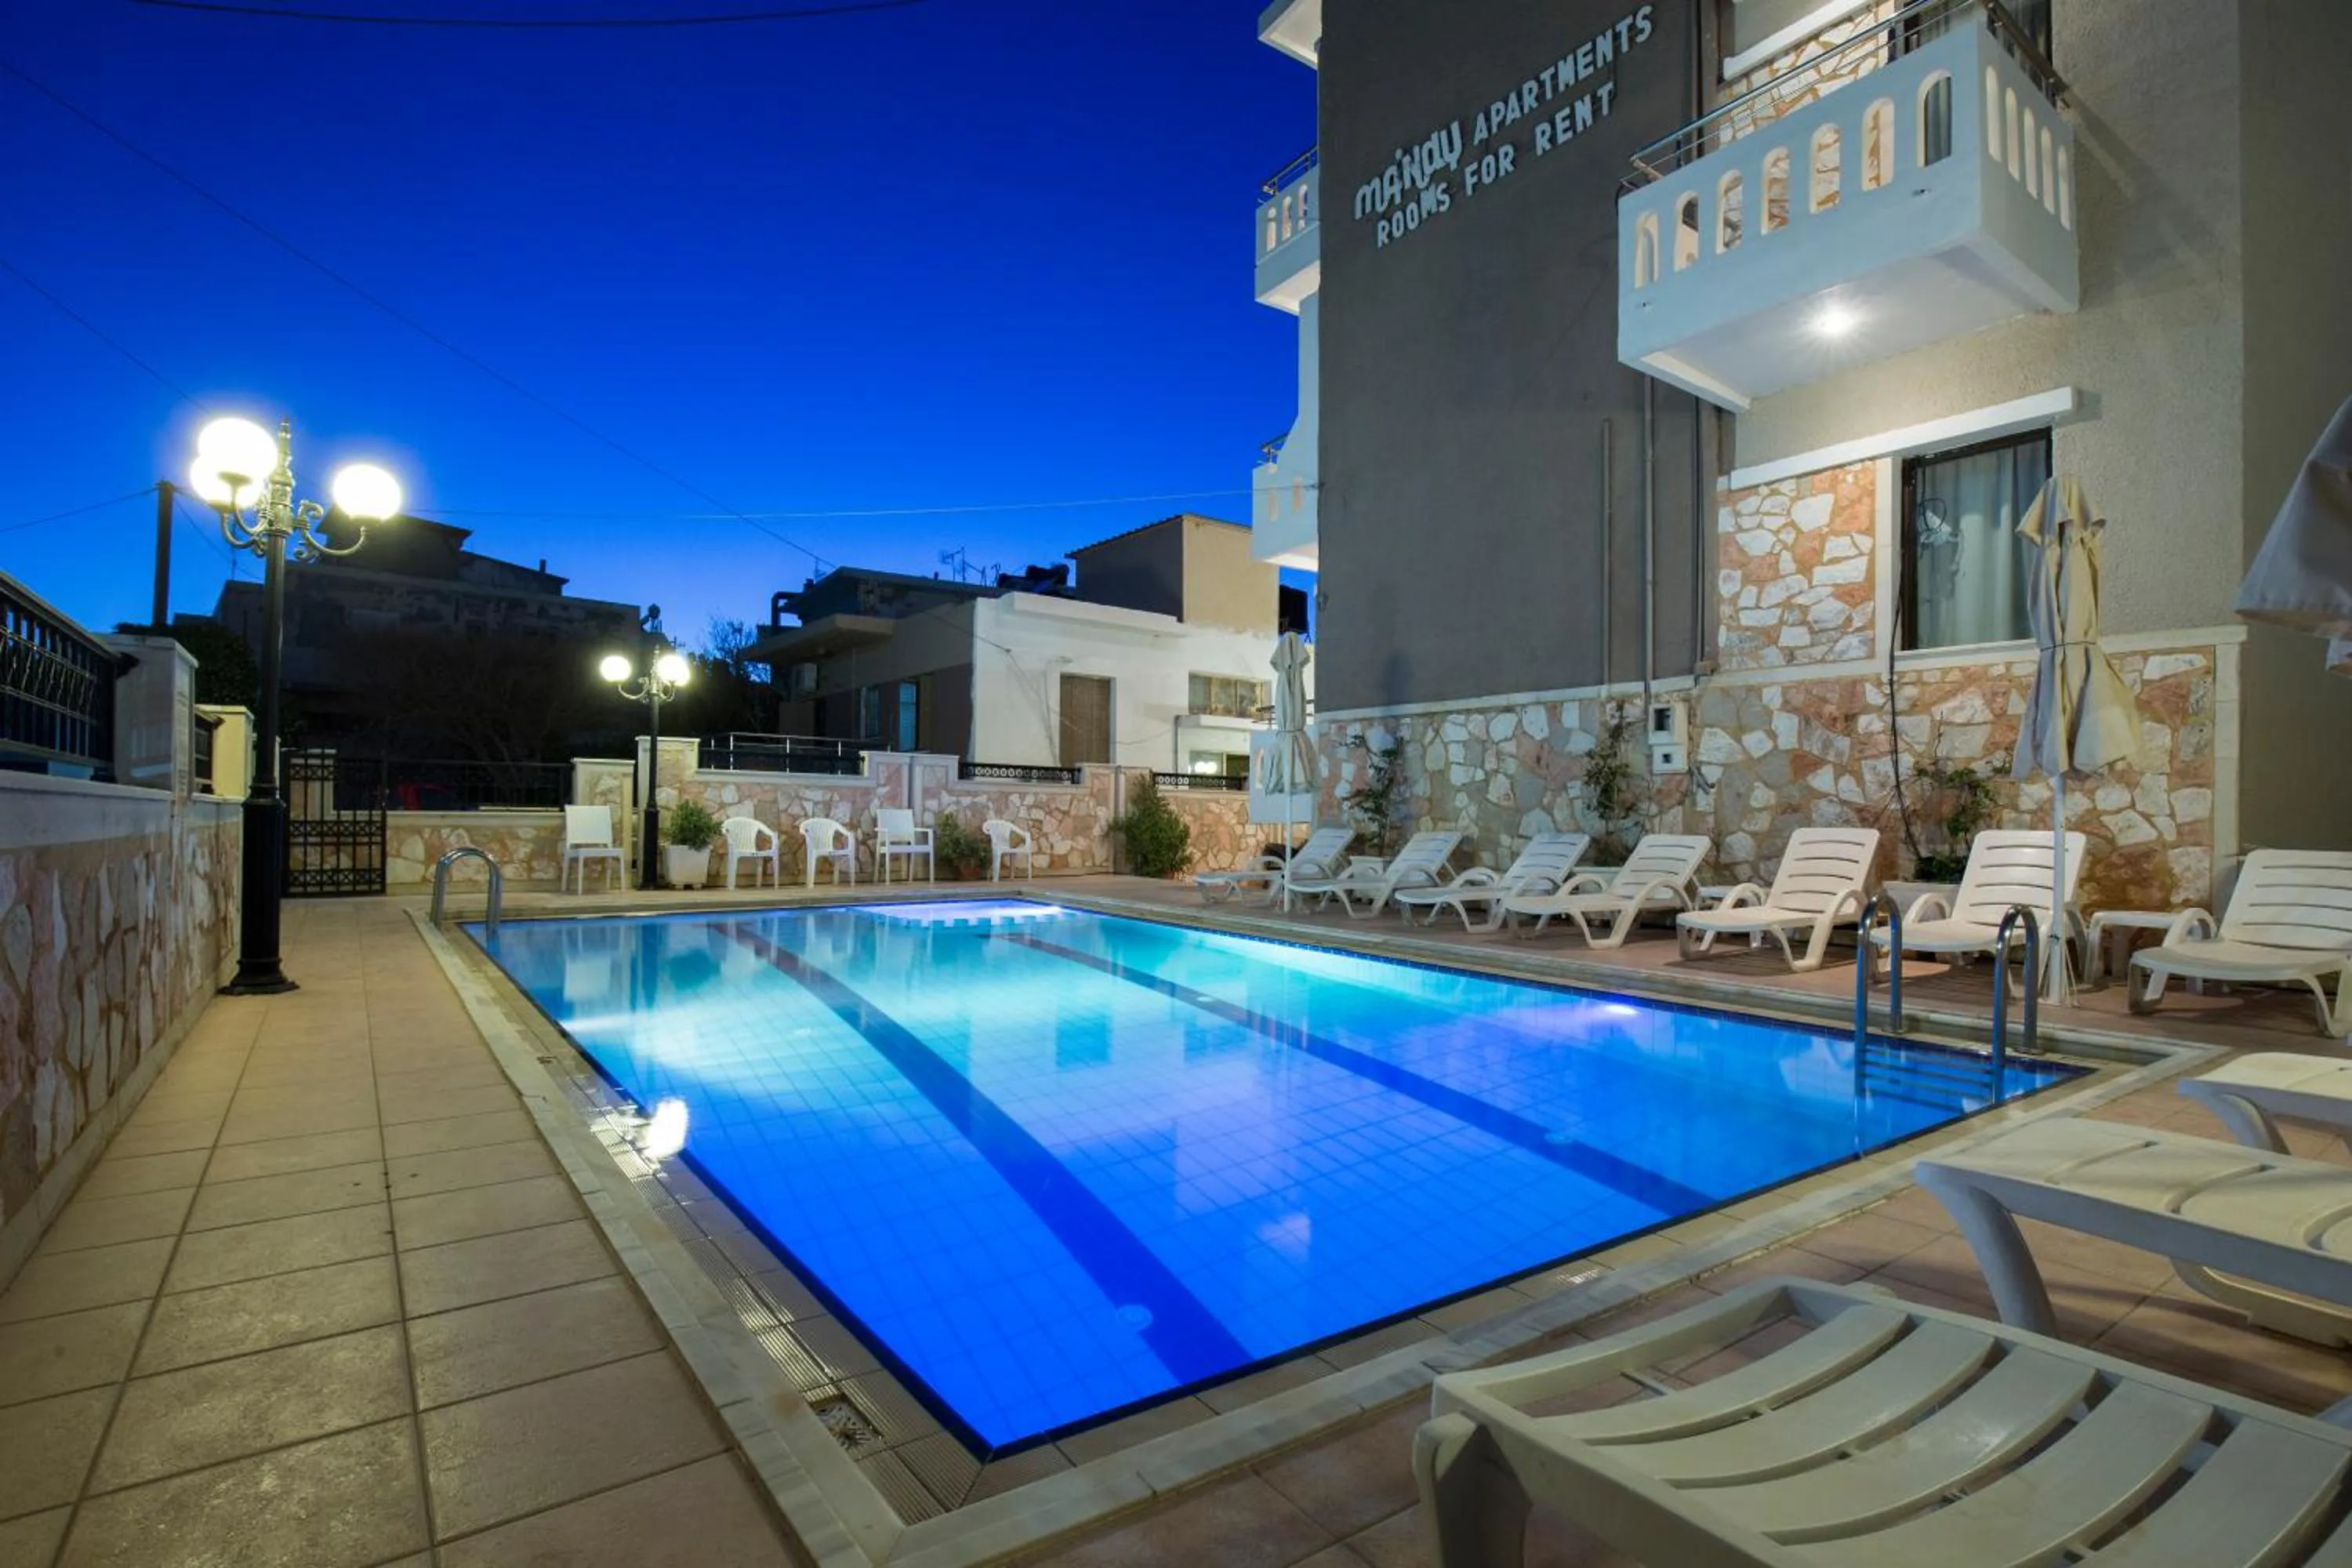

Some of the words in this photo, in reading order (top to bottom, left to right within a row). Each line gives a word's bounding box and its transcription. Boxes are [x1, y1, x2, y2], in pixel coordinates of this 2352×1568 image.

[1474, 5, 1653, 146] APARTMENTS
[1377, 181, 1451, 249] ROOMS
[1464, 144, 1515, 197] FOR
[1534, 82, 1614, 156] RENT
